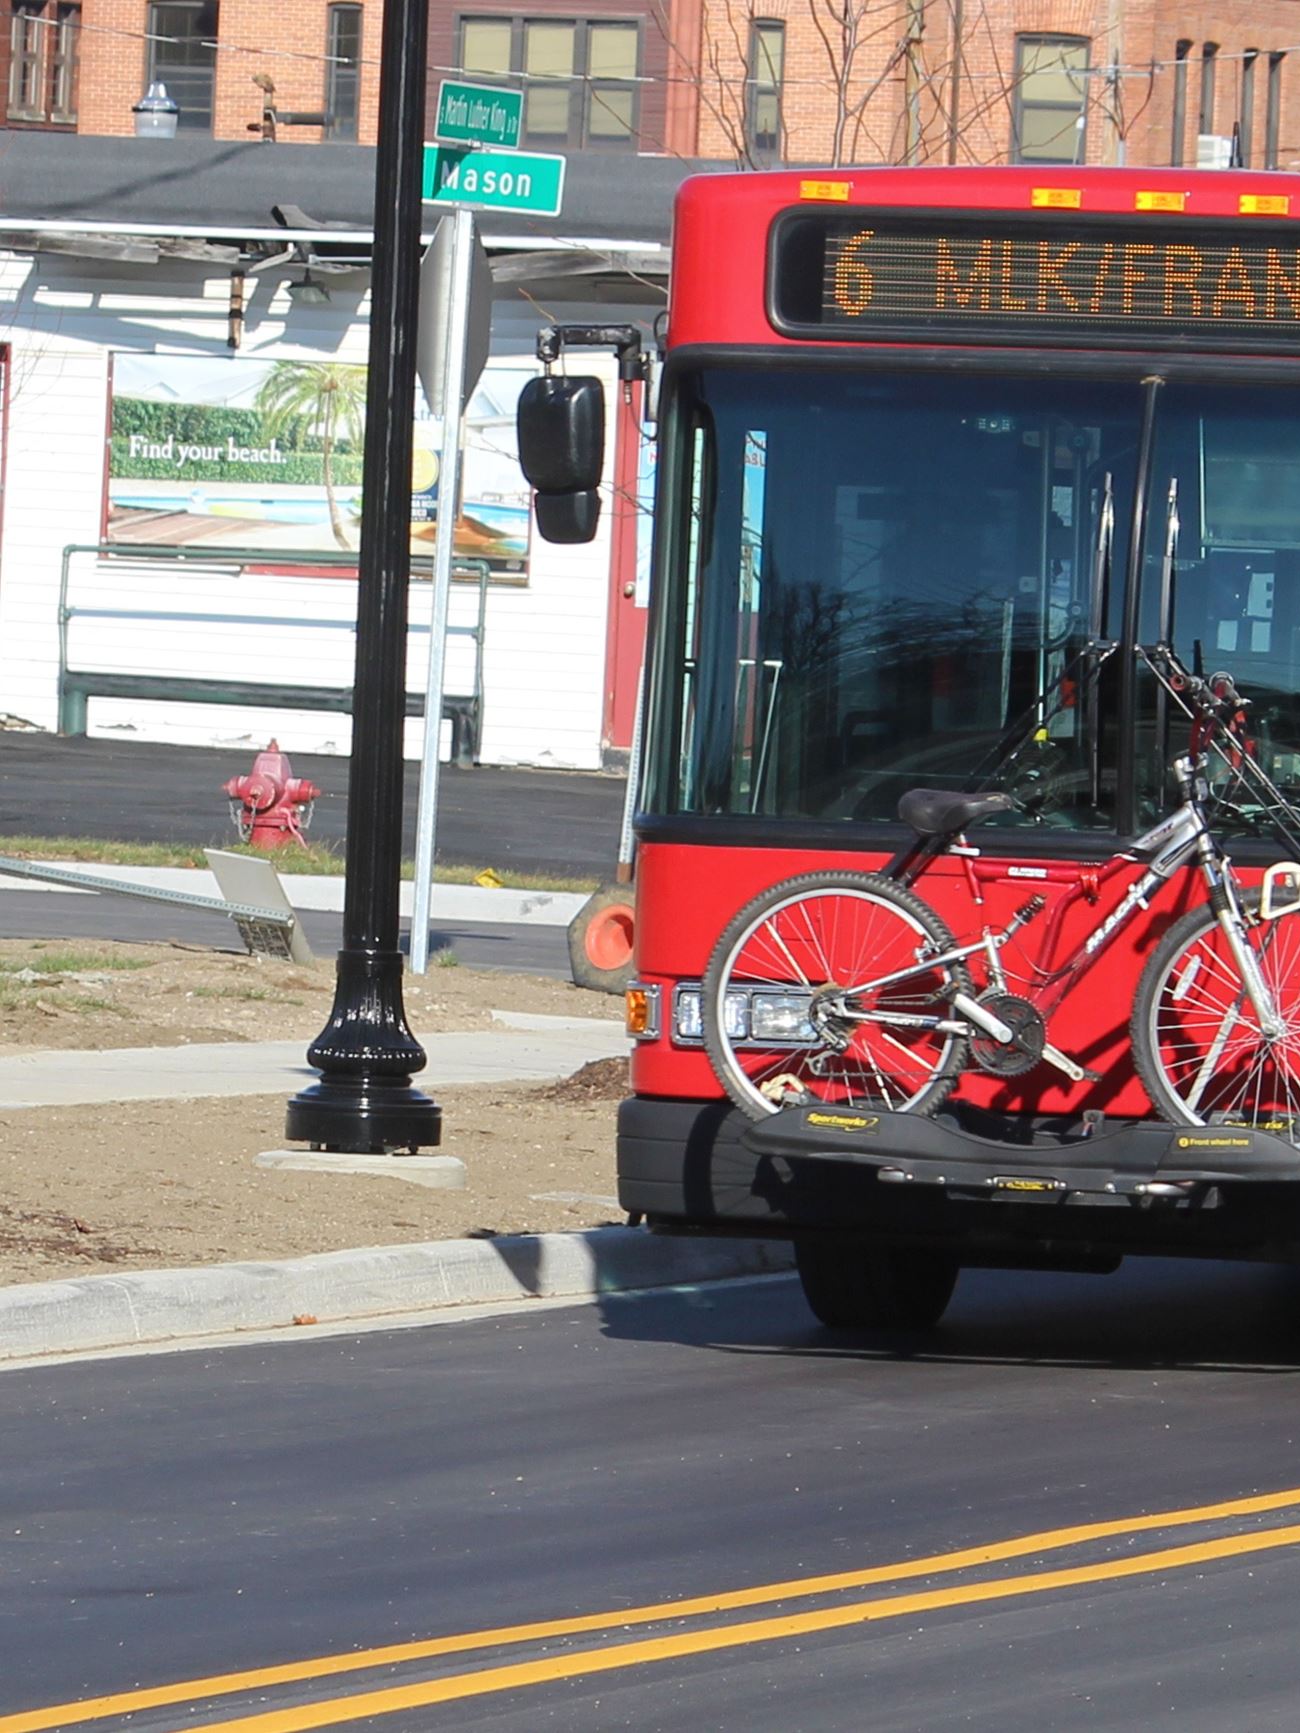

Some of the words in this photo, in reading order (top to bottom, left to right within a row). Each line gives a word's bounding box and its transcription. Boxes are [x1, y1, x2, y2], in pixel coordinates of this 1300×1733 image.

[445, 94, 468, 127] Martin
[468, 99, 490, 130] Luther
[489, 100, 507, 141] King
[441, 160, 531, 198] Mason
[834, 230, 875, 317] 6
[128, 434, 174, 459] Find
[176, 445, 224, 467] your
[227, 436, 287, 463] beach.
[807, 1112, 868, 1127] Sportworks
[1190, 1138, 1210, 1146] Front
[1210, 1138, 1232, 1146] wheel
[1232, 1138, 1249, 1146] here
